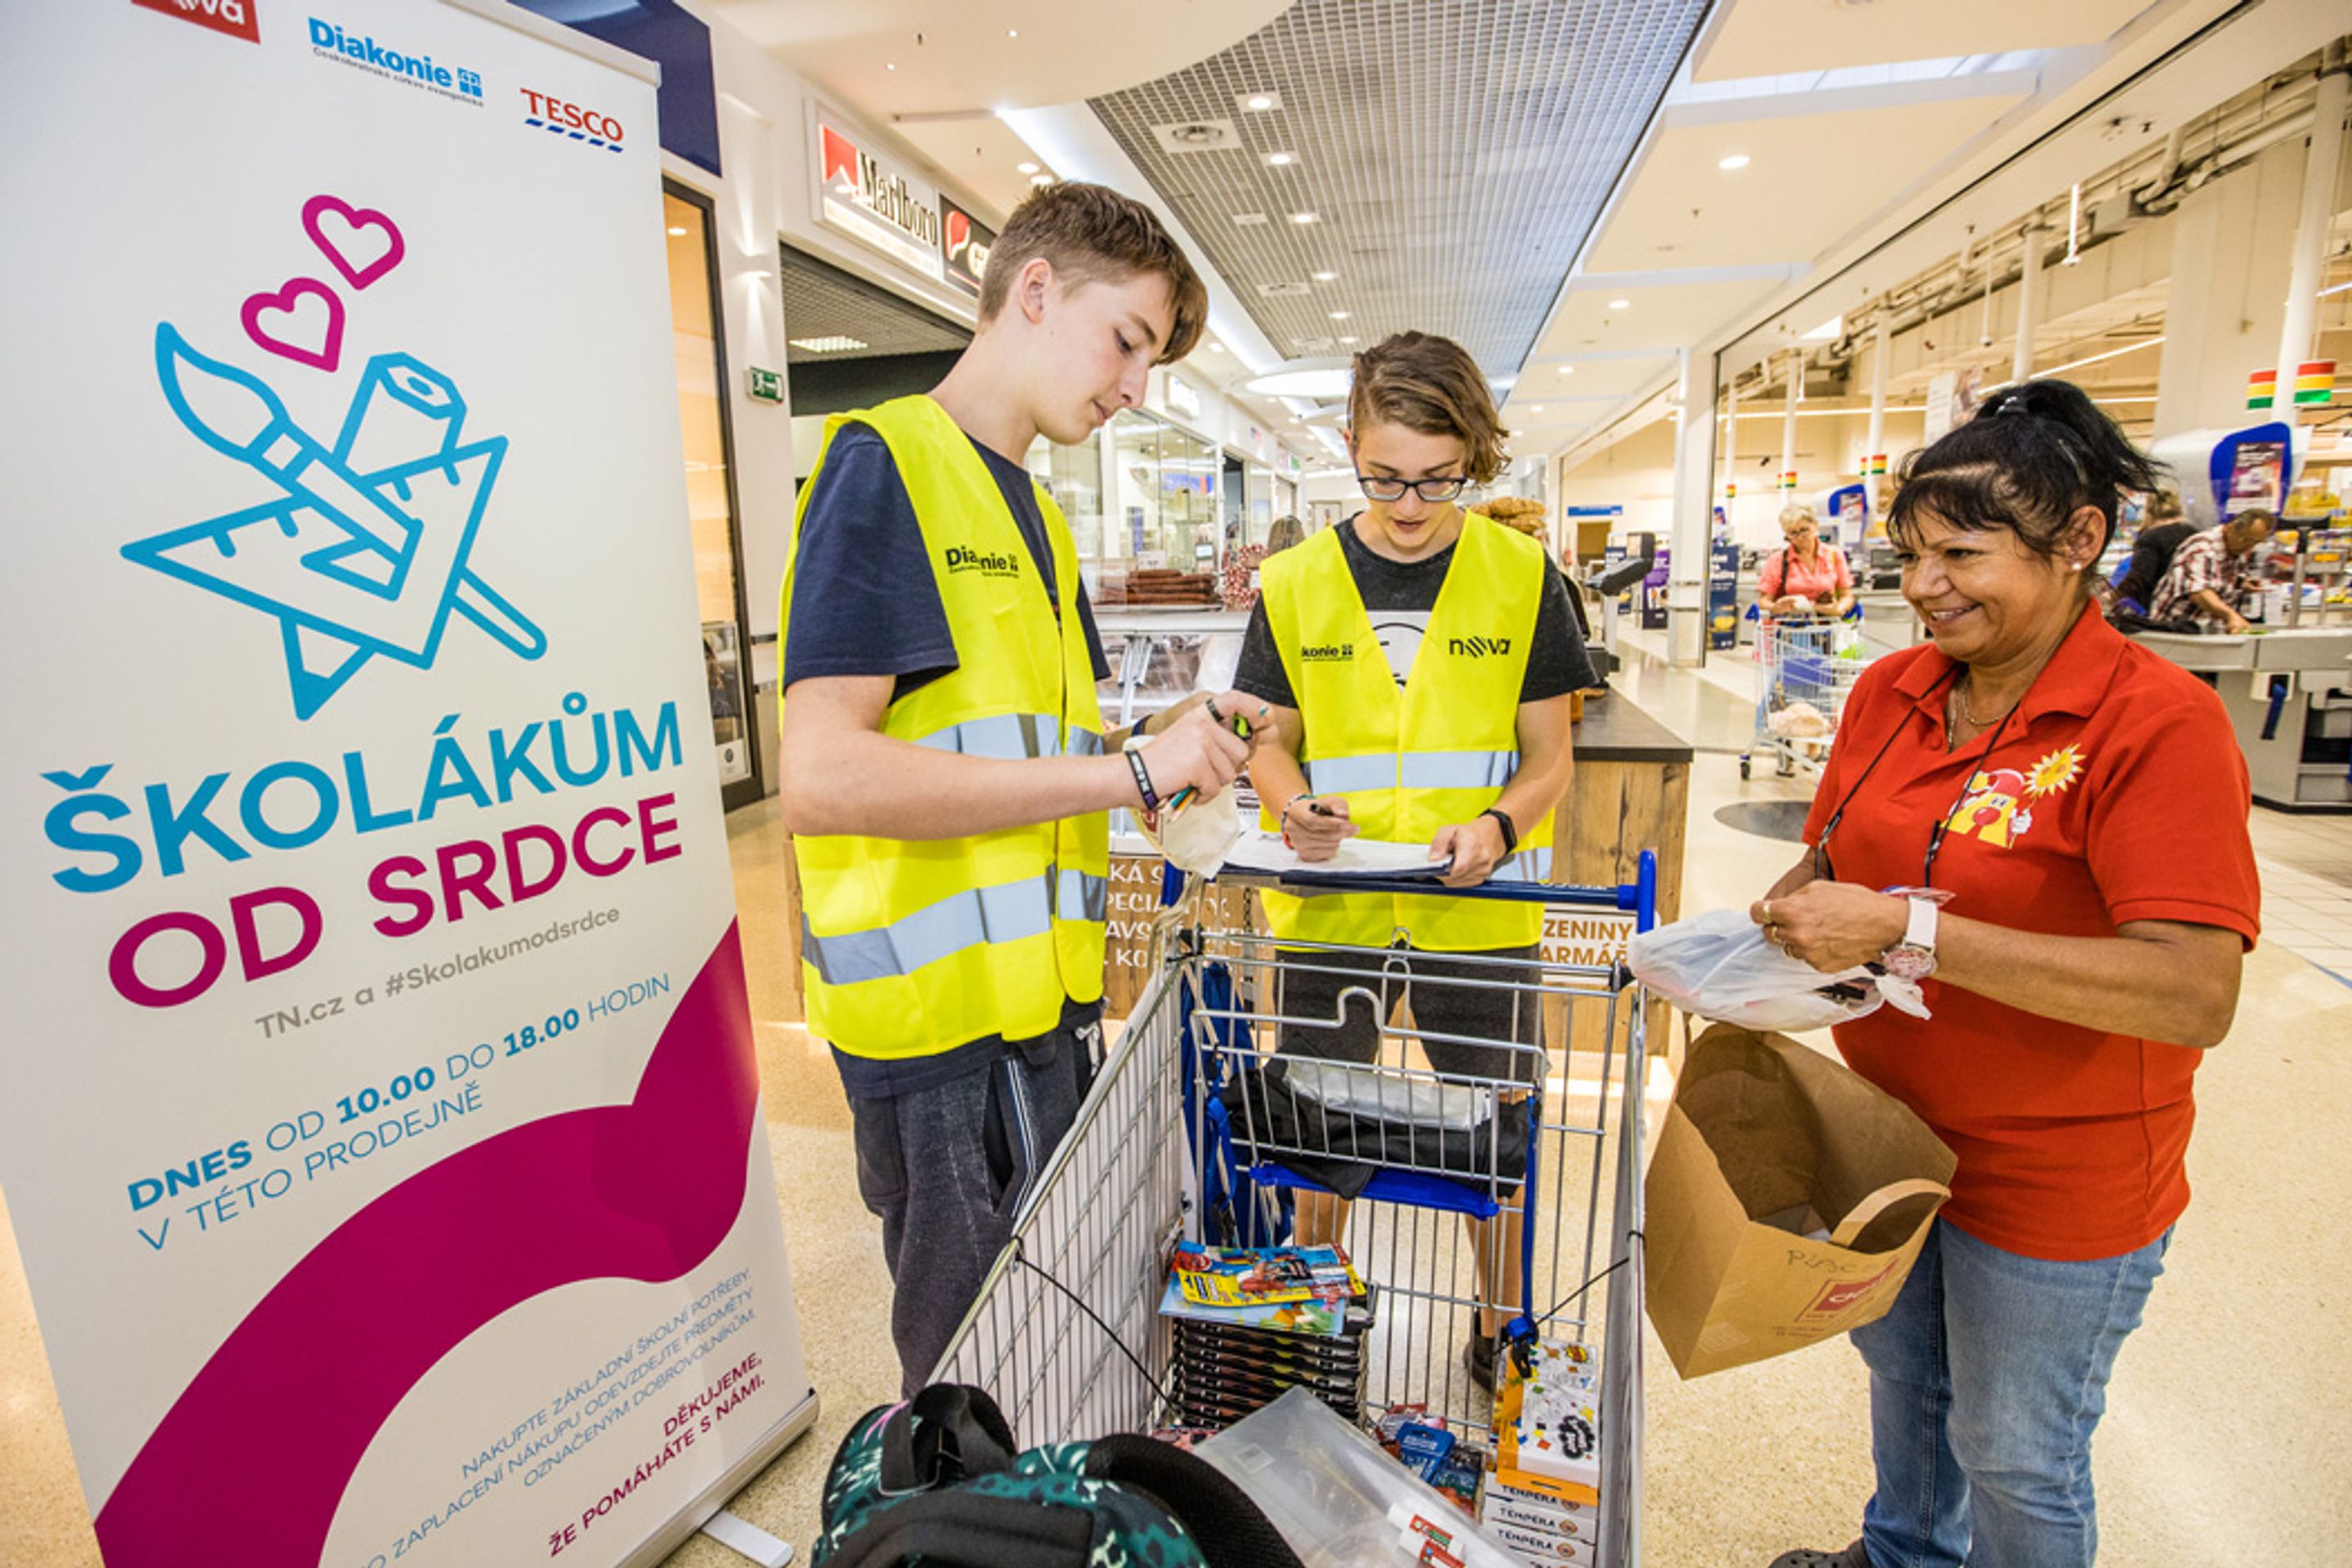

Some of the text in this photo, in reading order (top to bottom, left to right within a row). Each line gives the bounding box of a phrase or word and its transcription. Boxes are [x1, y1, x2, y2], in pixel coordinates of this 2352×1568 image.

[308, 16, 452, 87] Diakonie
[519, 87, 623, 142] TESCO
[860, 151, 938, 247] Marlboro
[945, 545, 1007, 570] Dianie
[39, 692, 684, 893] ŠKOLÁKŮM
[108, 792, 683, 1008] OD SRDCE
[255, 906, 620, 1040] TN.cz a #Skolakumodsrdce
[127, 973, 671, 1211] DNES OD 10.00 DO 18.00 HODIN
[137, 1081, 483, 1251] V TÉTO PRODEJNĚ
[393, 1463, 504, 1558] ZAPLACENÍ
[507, 1413, 581, 1472] NÁKUPU
[584, 1339, 681, 1417] ODEVZDEJTE
[462, 1409, 547, 1478] NAKUPTE
[553, 1346, 634, 1415] ZÁKLADNÍ
[638, 1306, 689, 1355] ŠKOLNÍ
[523, 1402, 630, 1487] OZNAČENÝM
[549, 1373, 766, 1558] ŽE POMÁHÁTE S NÁMI.
[662, 1352, 763, 1437] DĚKUJEME,
